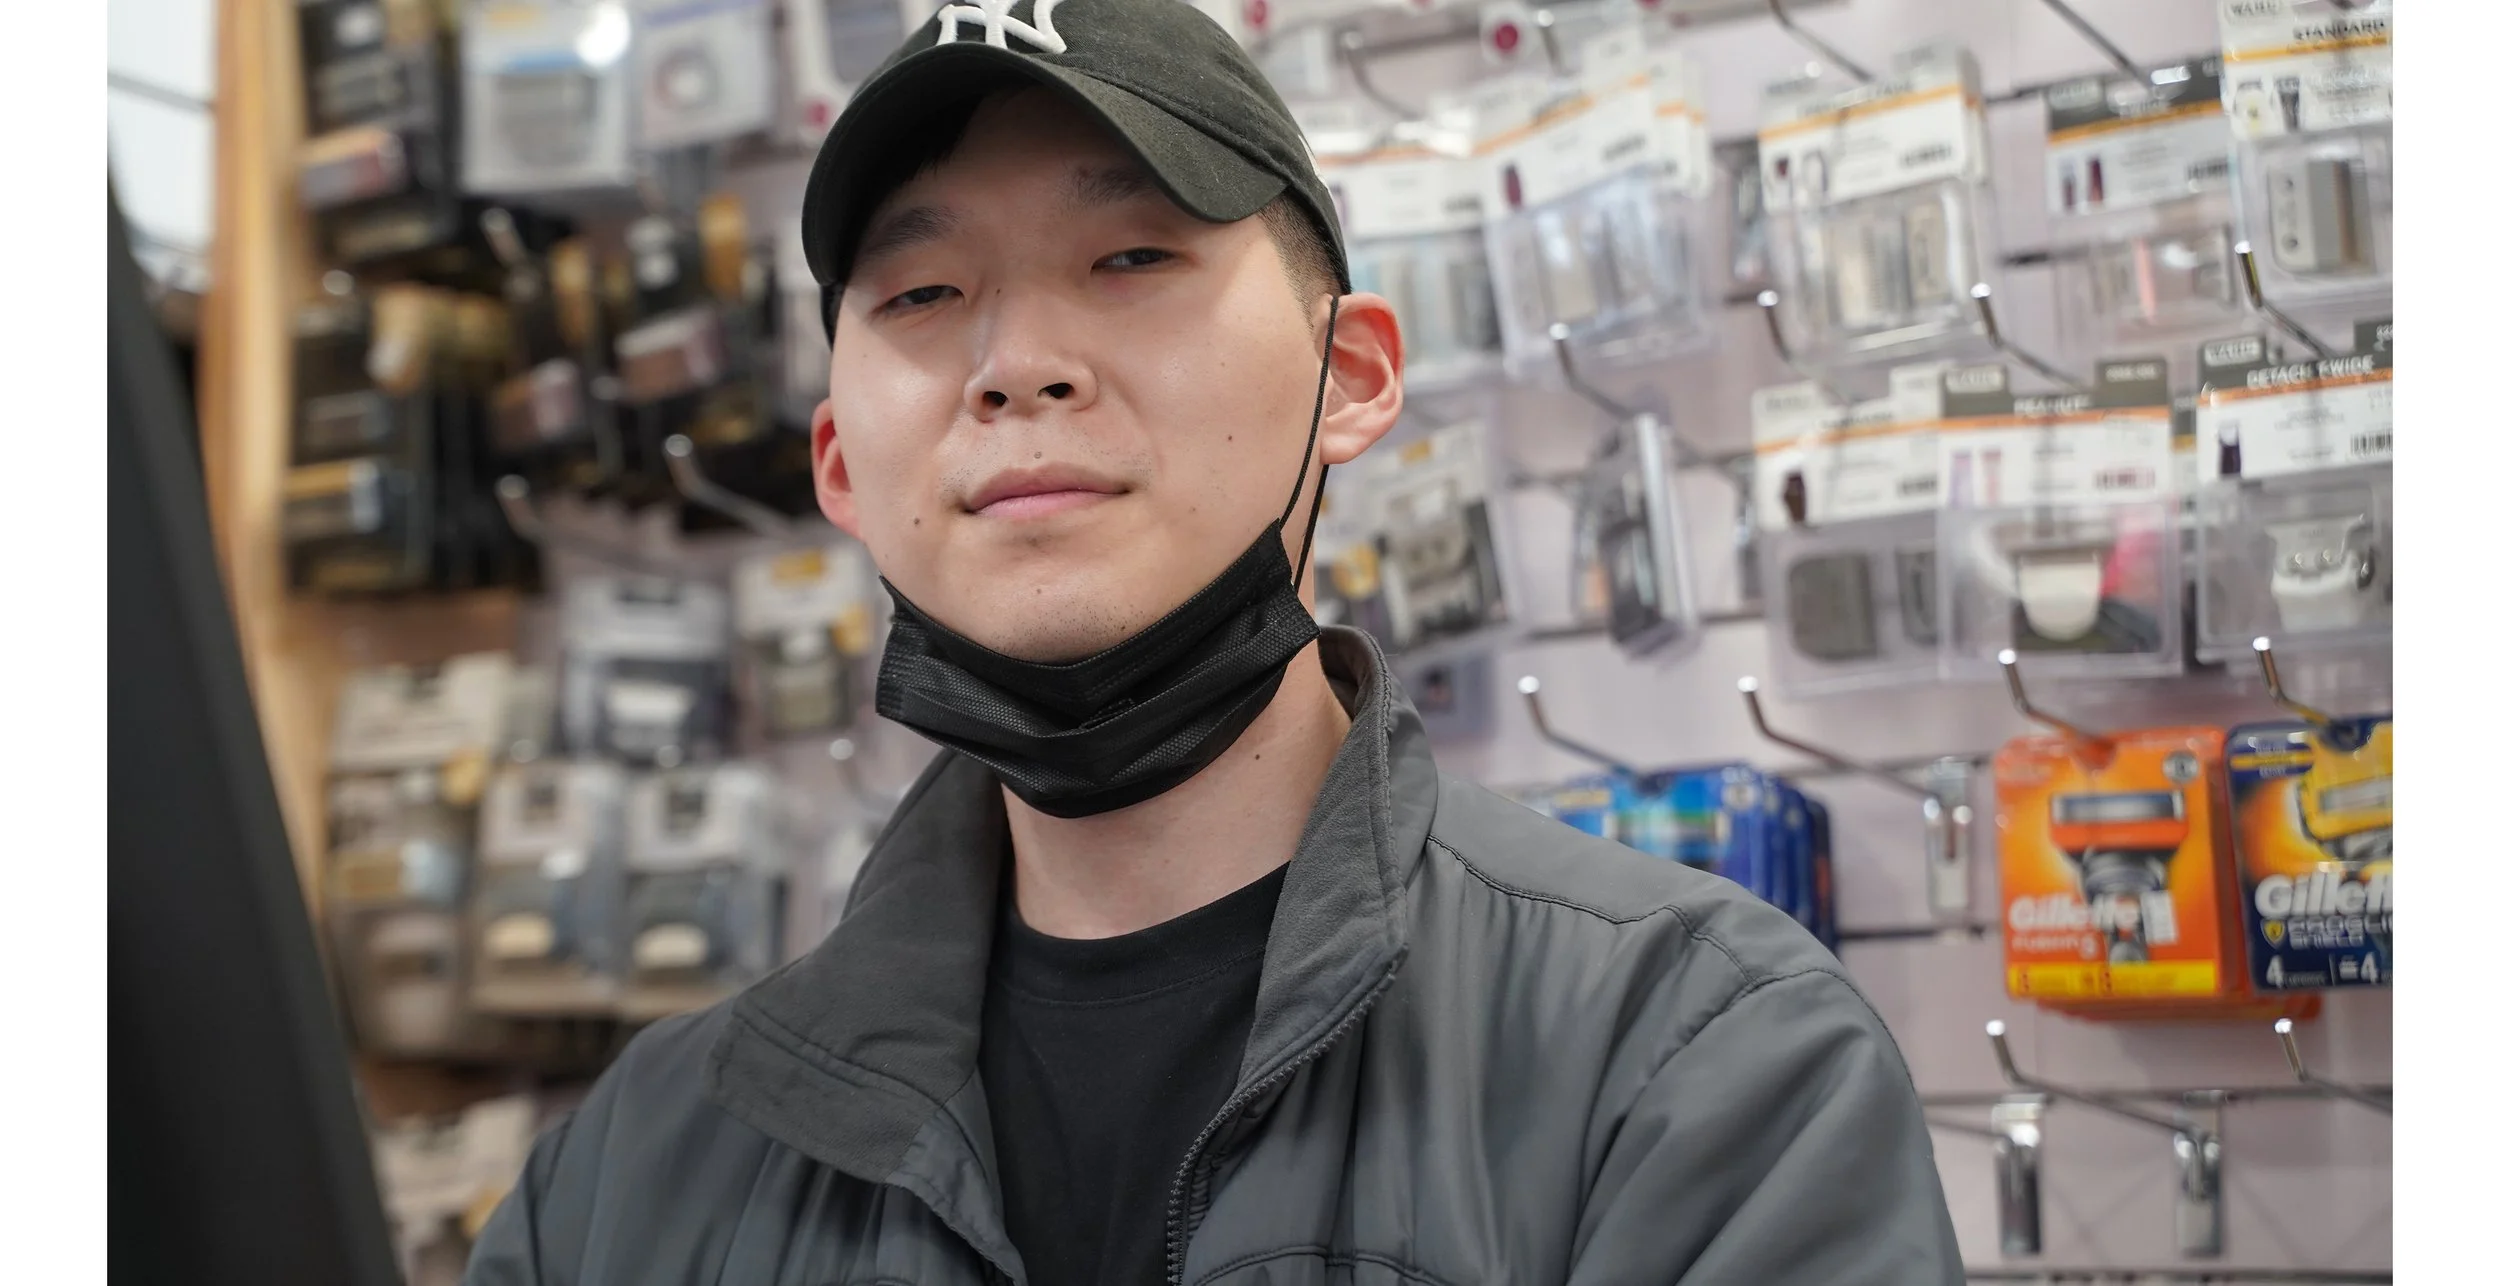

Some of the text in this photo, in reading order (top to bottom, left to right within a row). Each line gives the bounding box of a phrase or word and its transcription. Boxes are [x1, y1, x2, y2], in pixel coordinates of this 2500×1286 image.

[2292, 18, 2386, 41] STANDARD
[2008, 892, 2142, 933] Gillette
[2266, 954, 2285, 990] 4
[2360, 951, 2380, 984] 4
